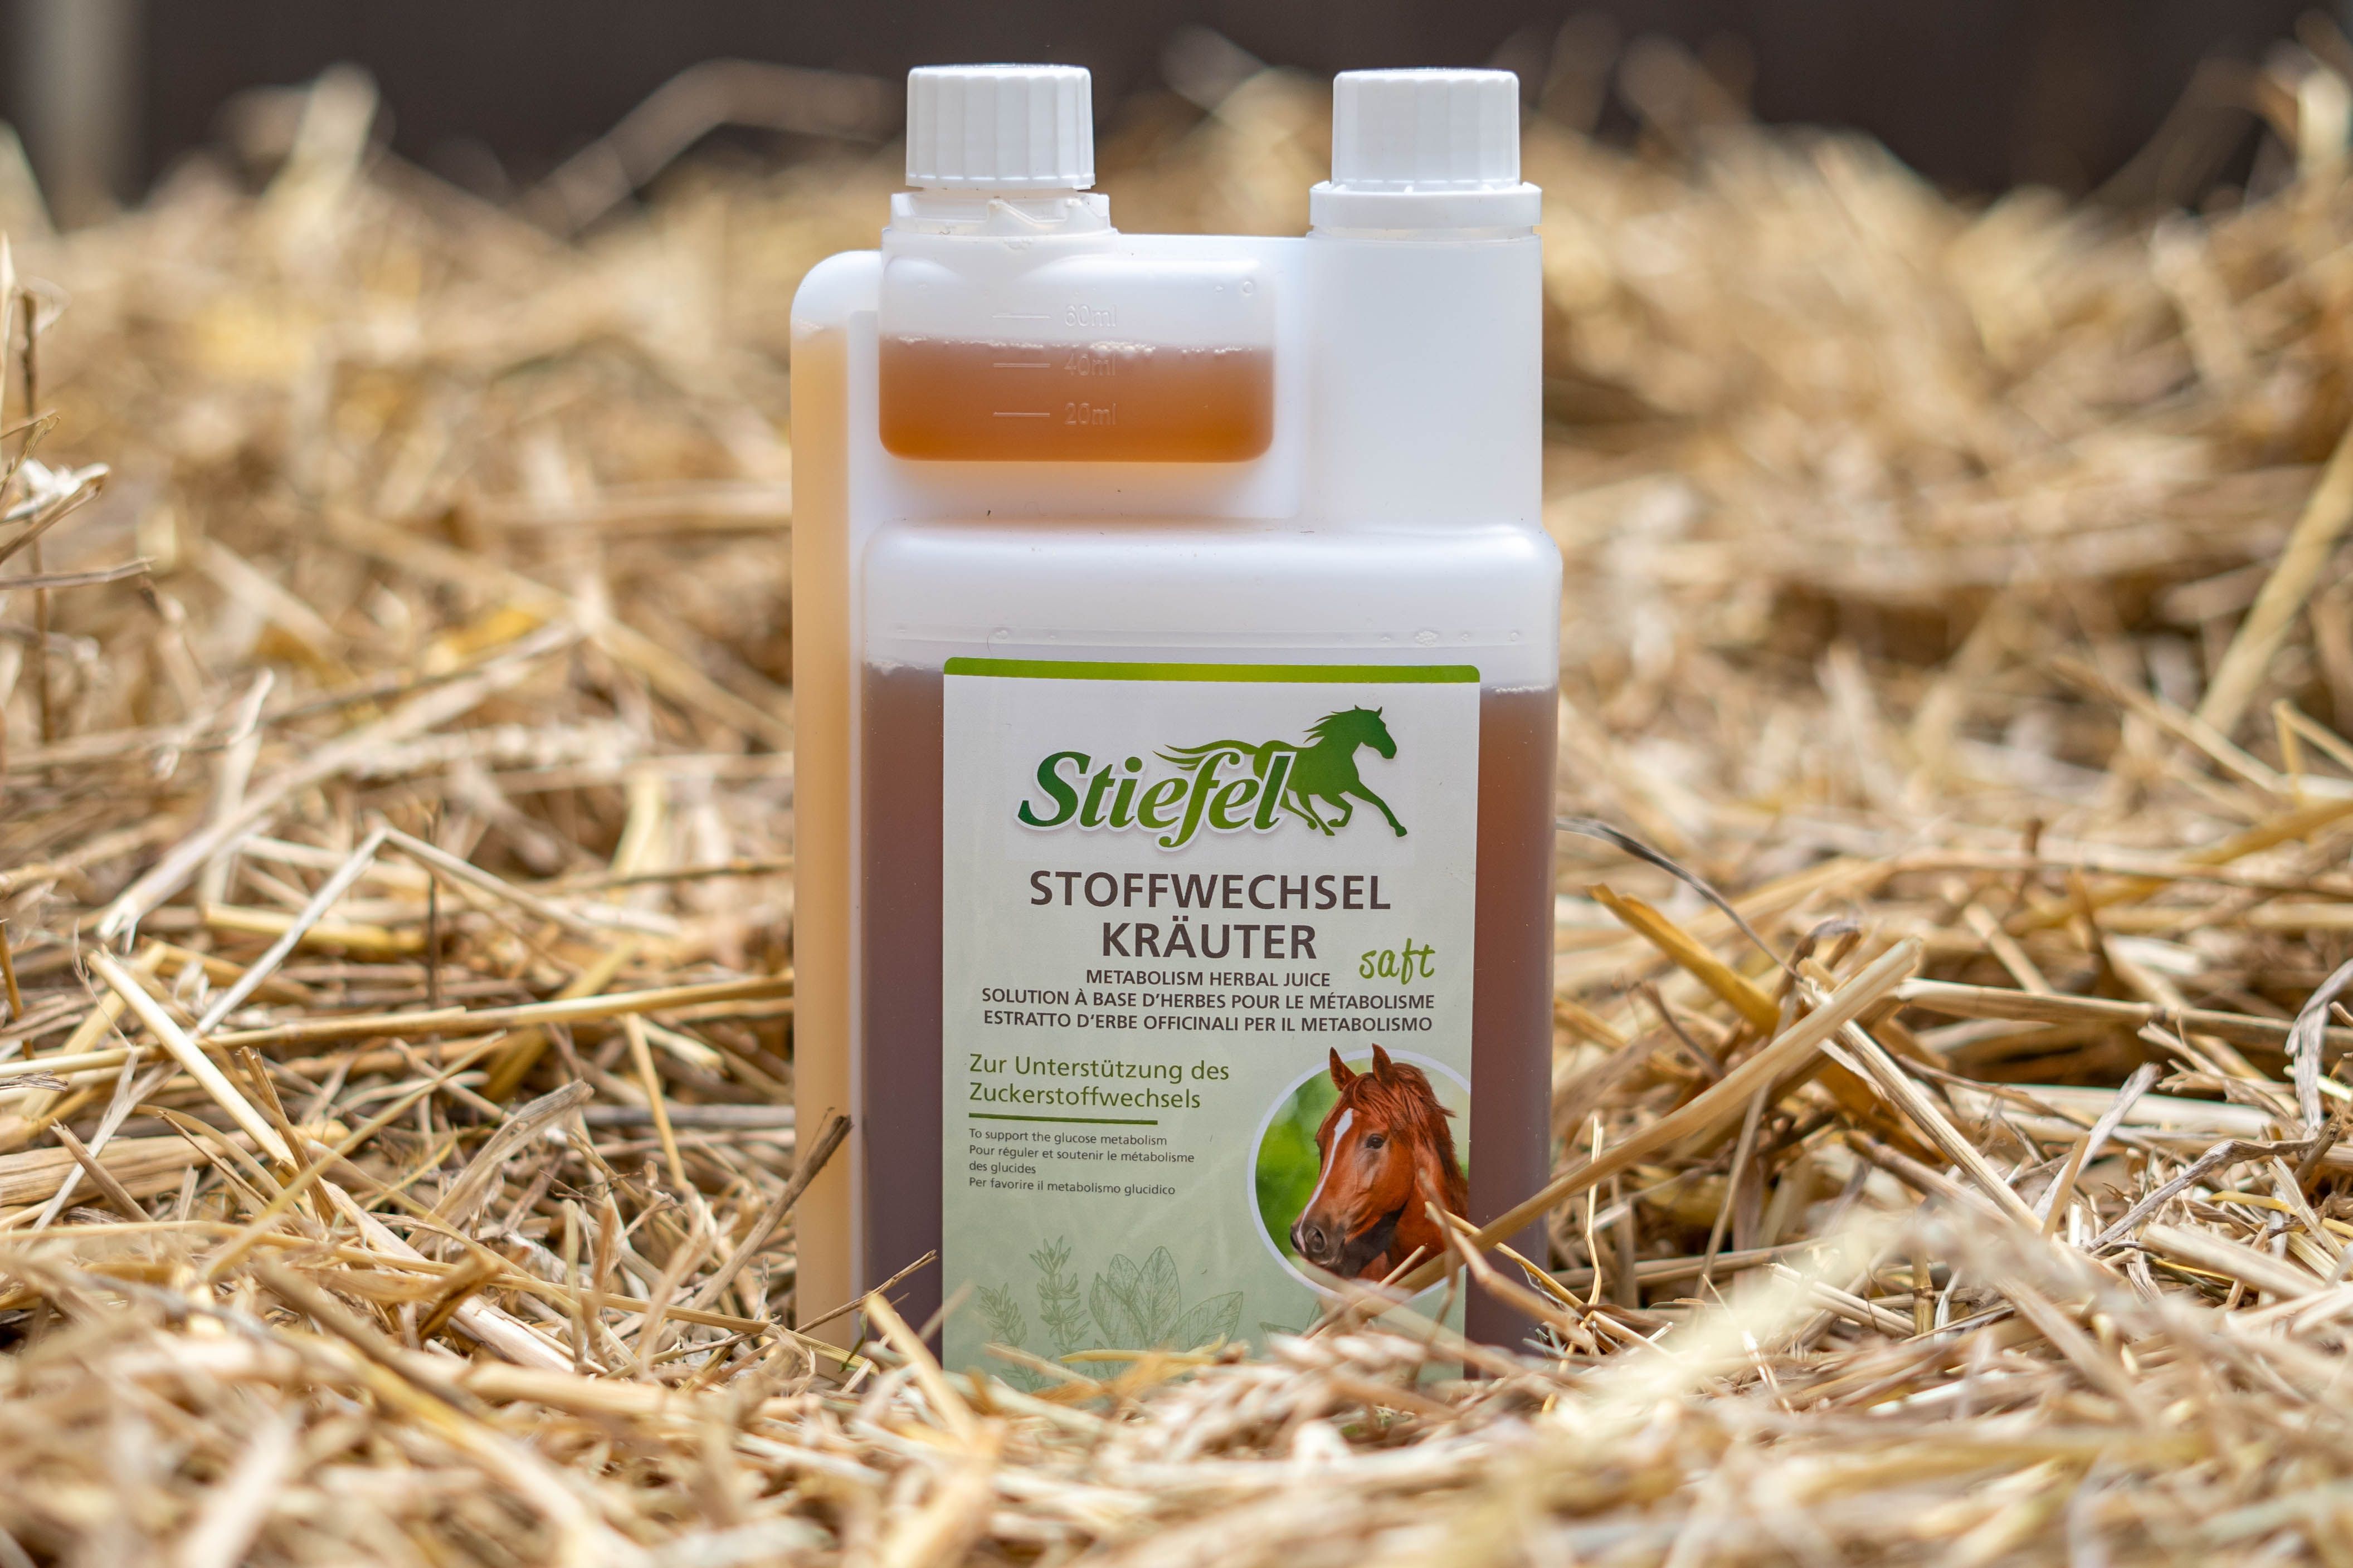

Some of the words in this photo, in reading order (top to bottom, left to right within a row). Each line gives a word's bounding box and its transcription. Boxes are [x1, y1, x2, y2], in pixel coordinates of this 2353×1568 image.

[1064, 305, 1117, 327] 60ml
[1064, 353, 1117, 377] 40ml
[1064, 402, 1117, 425] 20ml
[1019, 749, 1290, 848] Stiefel
[1031, 871, 1391, 910] STOFFWECHSEL
[1103, 914, 1317, 959] KRÄUTER
[1360, 938, 1435, 985] saft
[1087, 970, 1202, 985] METABOLISM
[1210, 972, 1278, 986] HERBAL
[1283, 973, 1330, 986] JUICE
[982, 988, 1069, 1005] SOLUTION
[1074, 988, 1088, 1005] À
[1094, 992, 1136, 1007] BASE
[1143, 993, 1226, 1008] D'HERBES
[1232, 995, 1279, 1009] POUR
[1286, 995, 1303, 1009] LE
[1310, 992, 1434, 1009] MÉTABOLISME
[985, 1010, 1071, 1027] ESTRATTO
[1078, 1014, 1137, 1029] D'ERBE
[1144, 1015, 1238, 1030] OFFICINALI
[1245, 1017, 1275, 1031] PER
[1282, 1018, 1295, 1031] IL
[1302, 1017, 1432, 1032] METABOLISMO
[970, 1053, 1007, 1073] Zur
[1016, 1056, 1182, 1084] Unterstützung
[1191, 1060, 1229, 1080] des
[970, 1082, 1200, 1108] Zuckerstoffwechsels
[969, 1129, 982, 1138] To
[985, 1131, 1029, 1142] support
[1032, 1132, 1051, 1142] the
[1054, 1132, 1097, 1145] glucose
[1101, 1135, 1167, 1145] metabolism
[970, 1145, 995, 1155] Pour
[998, 1147, 1039, 1160] réguler
[1042, 1150, 1053, 1159] et
[1057, 1150, 1104, 1160] soutenir
[1108, 1150, 1117, 1161] le
[1121, 1151, 1194, 1162] métabolisme
[969, 1160, 987, 1171] des
[991, 1162, 1036, 1175] glucides
[969, 1177, 987, 1187] Per
[990, 1178, 1034, 1190] favorire
[1037, 1180, 1043, 1190] il
[1048, 1181, 1121, 1193] metabolismo
[1124, 1184, 1175, 1196] glucidico
